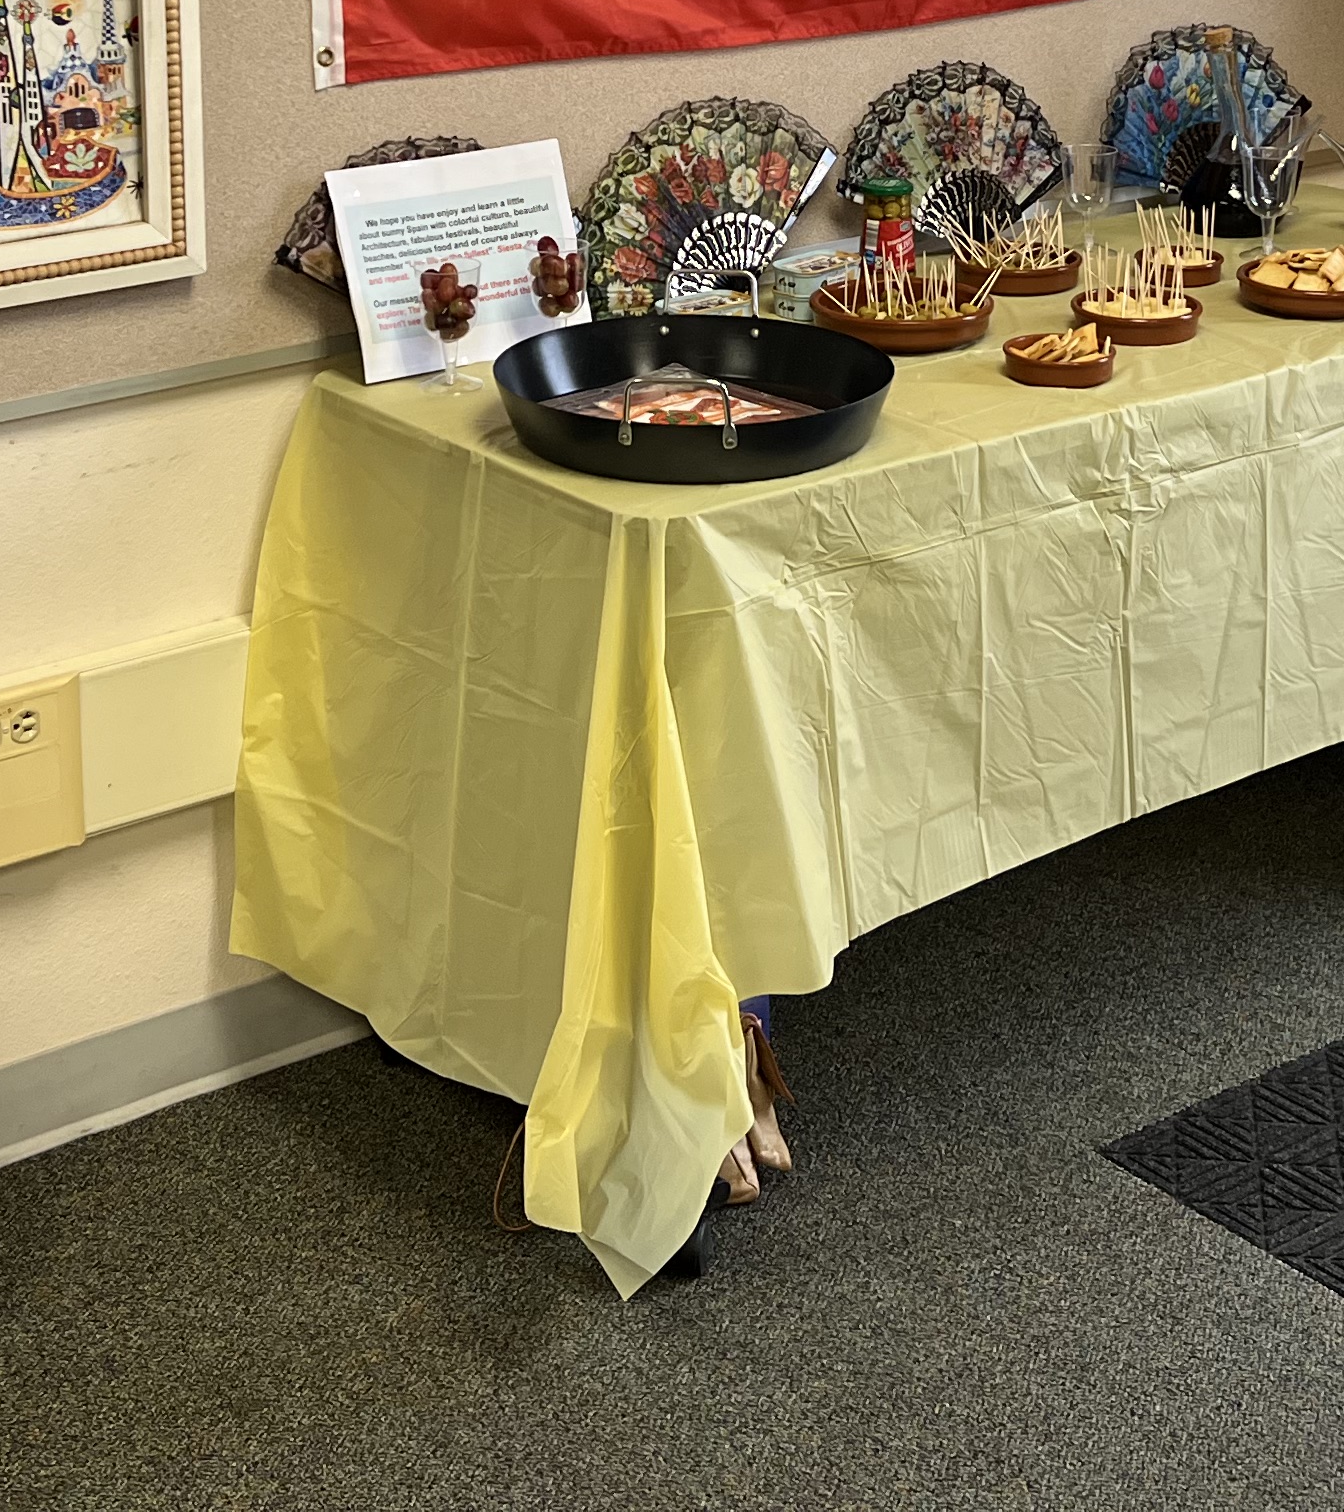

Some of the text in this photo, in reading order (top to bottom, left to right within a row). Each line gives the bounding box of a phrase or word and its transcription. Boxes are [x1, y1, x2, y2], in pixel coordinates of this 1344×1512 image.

[359, 231, 380, 240] about
[407, 225, 428, 234] Spain
[430, 221, 447, 229] with
[448, 215, 479, 227] colorful
[514, 203, 549, 216] beautiful
[380, 217, 399, 226] hope
[400, 215, 415, 224] you
[416, 212, 435, 221] have
[437, 209, 458, 218] enjoy
[461, 204, 476, 213] and
[478, 201, 498, 210] learn
[398, 247, 432, 258] delicious
[434, 243, 452, 252] food
[454, 240, 469, 249] and
[471, 237, 479, 246] of
[481, 234, 508, 245] course
[510, 229, 539, 240] always
[410, 233, 444, 244] fabulous
[483, 220, 519, 232] beautiful
[369, 276, 383, 285] and
[373, 299, 387, 308] Our
[490, 280, 511, 289] there
[513, 275, 528, 285] and
[479, 289, 518, 302] wonderful
